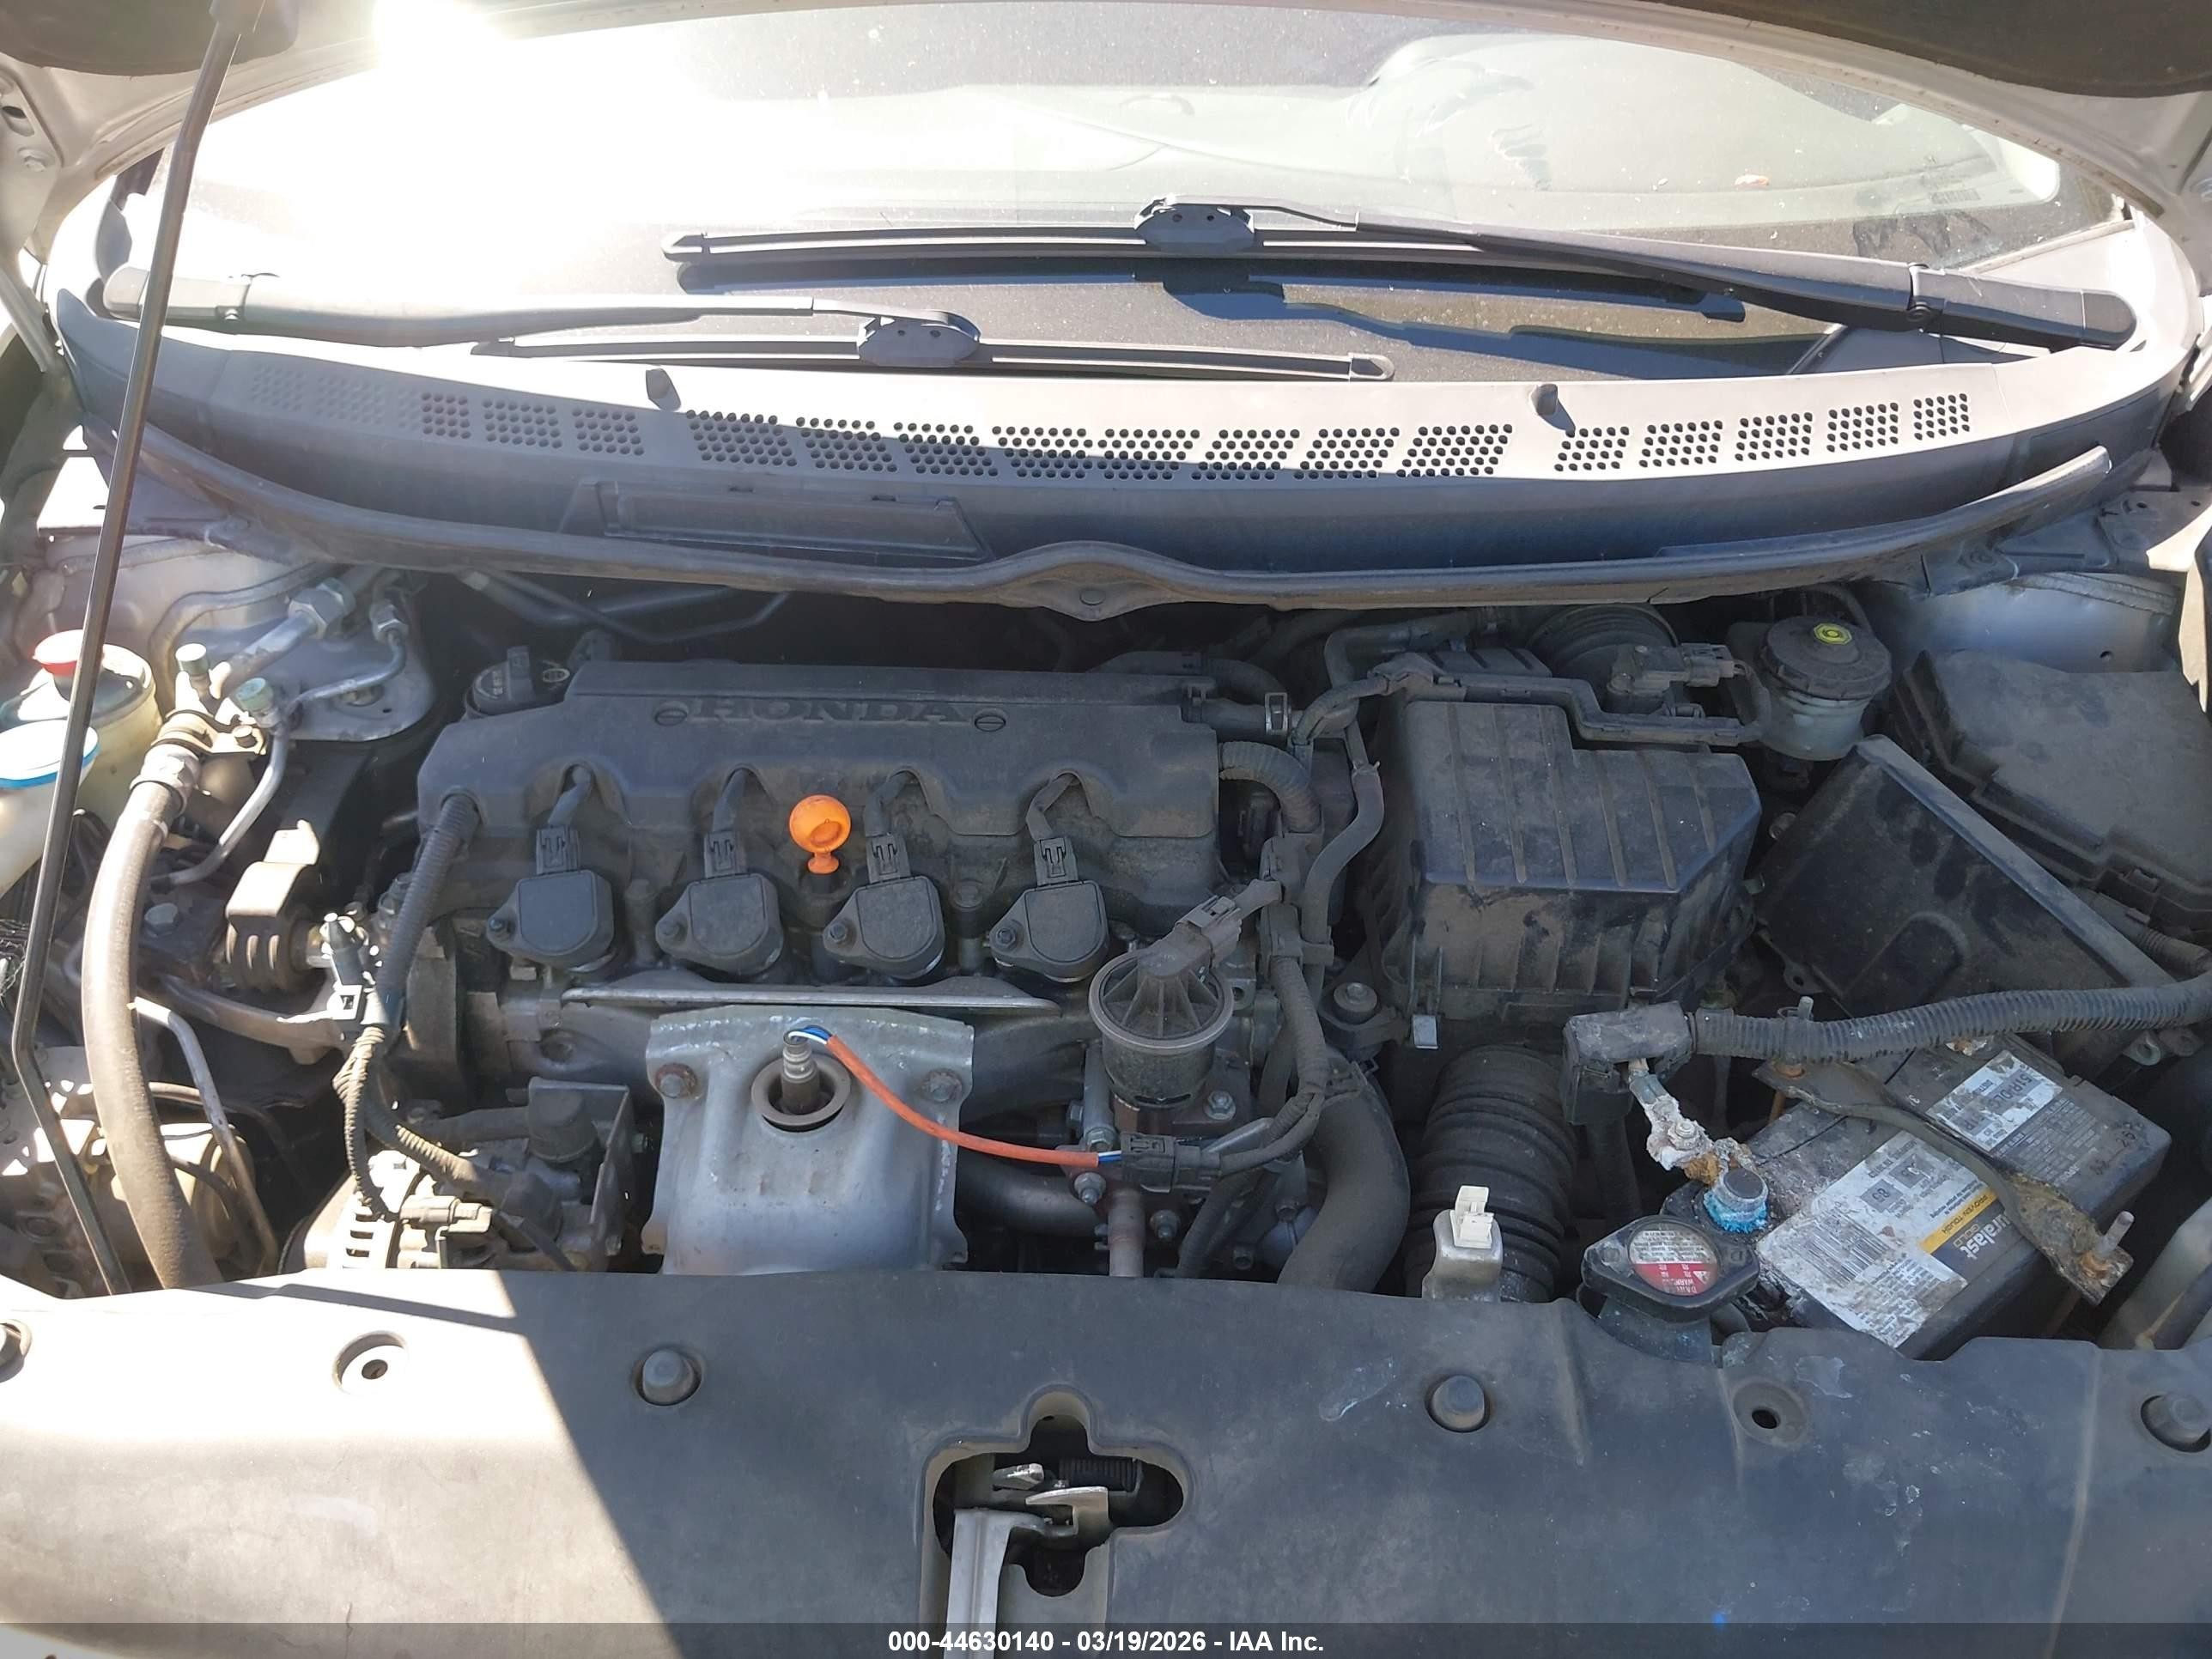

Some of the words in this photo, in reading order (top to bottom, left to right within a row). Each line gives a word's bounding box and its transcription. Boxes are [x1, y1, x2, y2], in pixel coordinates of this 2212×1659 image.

[690, 697, 971, 724] HONDA
[1870, 1187, 1891, 1203] 85
[1962, 1194, 1988, 1217] PROVEN
[1941, 1215, 1962, 1234] TOUGH
[1952, 1224, 1979, 1247] GOLD
[1959, 1212, 2011, 1260] uralast
